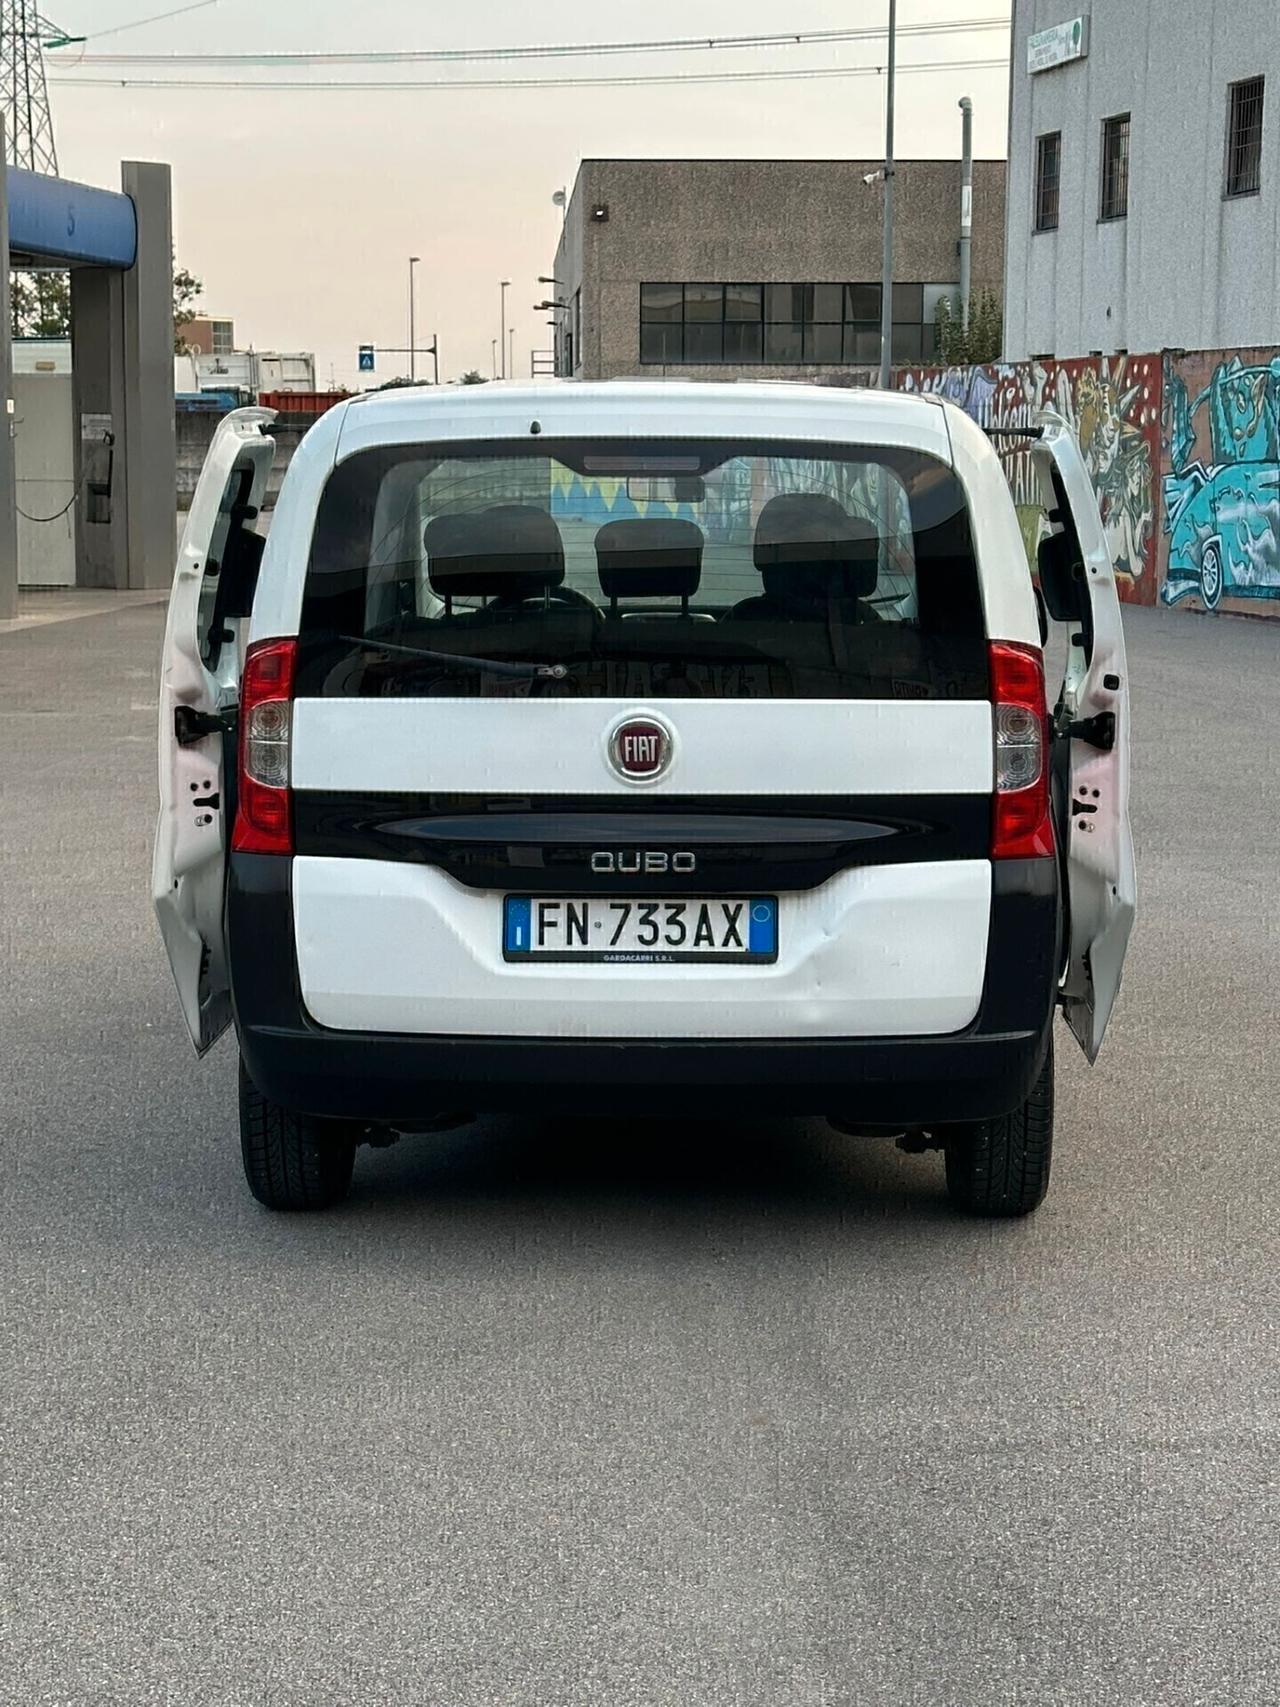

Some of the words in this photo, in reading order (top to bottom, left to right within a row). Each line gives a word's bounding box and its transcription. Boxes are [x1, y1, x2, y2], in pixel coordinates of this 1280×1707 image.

[624, 735, 659, 763] FIAT
[591, 851, 696, 873] QUBO
[538, 902, 589, 946] FN
[608, 902, 744, 948] 733AX
